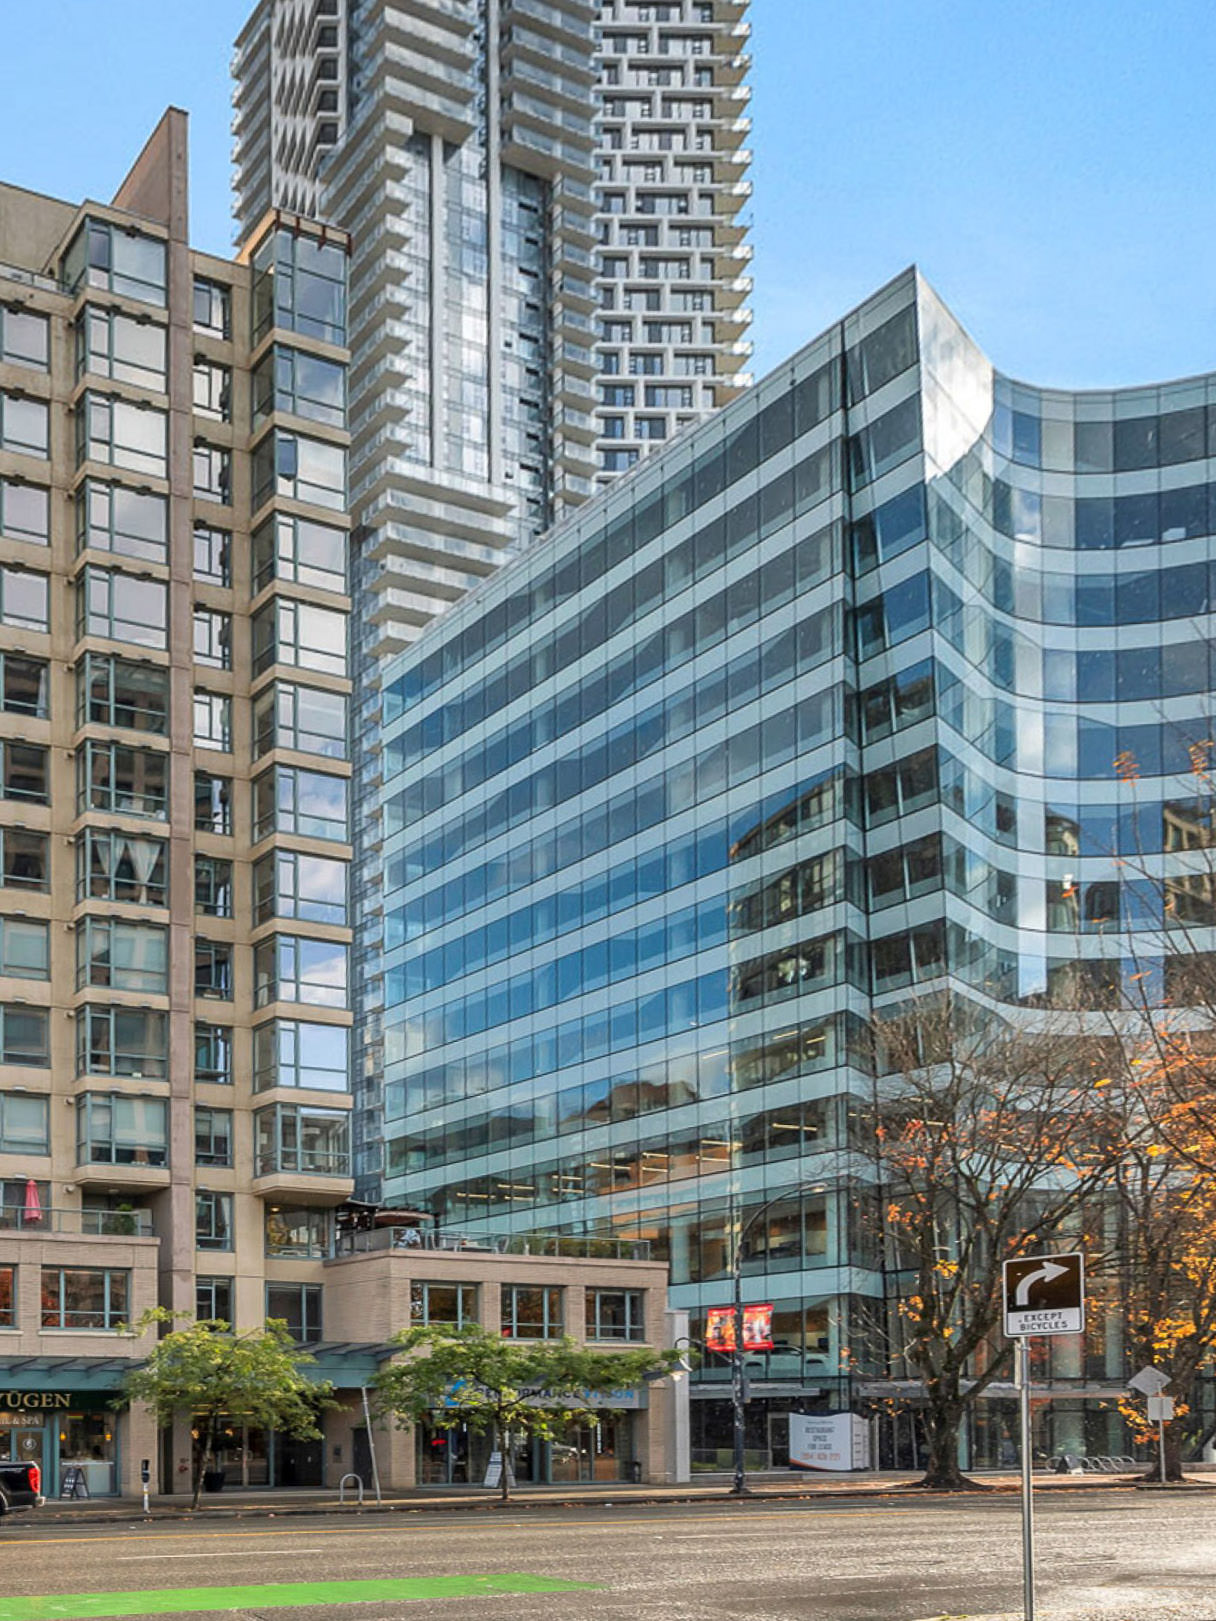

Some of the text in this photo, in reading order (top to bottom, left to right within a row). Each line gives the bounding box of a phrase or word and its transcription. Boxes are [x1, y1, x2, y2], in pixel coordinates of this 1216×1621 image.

[1023, 1311, 1063, 1323] EXCEPT
[1019, 1321, 1069, 1332] BICYCLES
[13, 1415, 20, 1425] &
[21, 1415, 40, 1425] SPA
